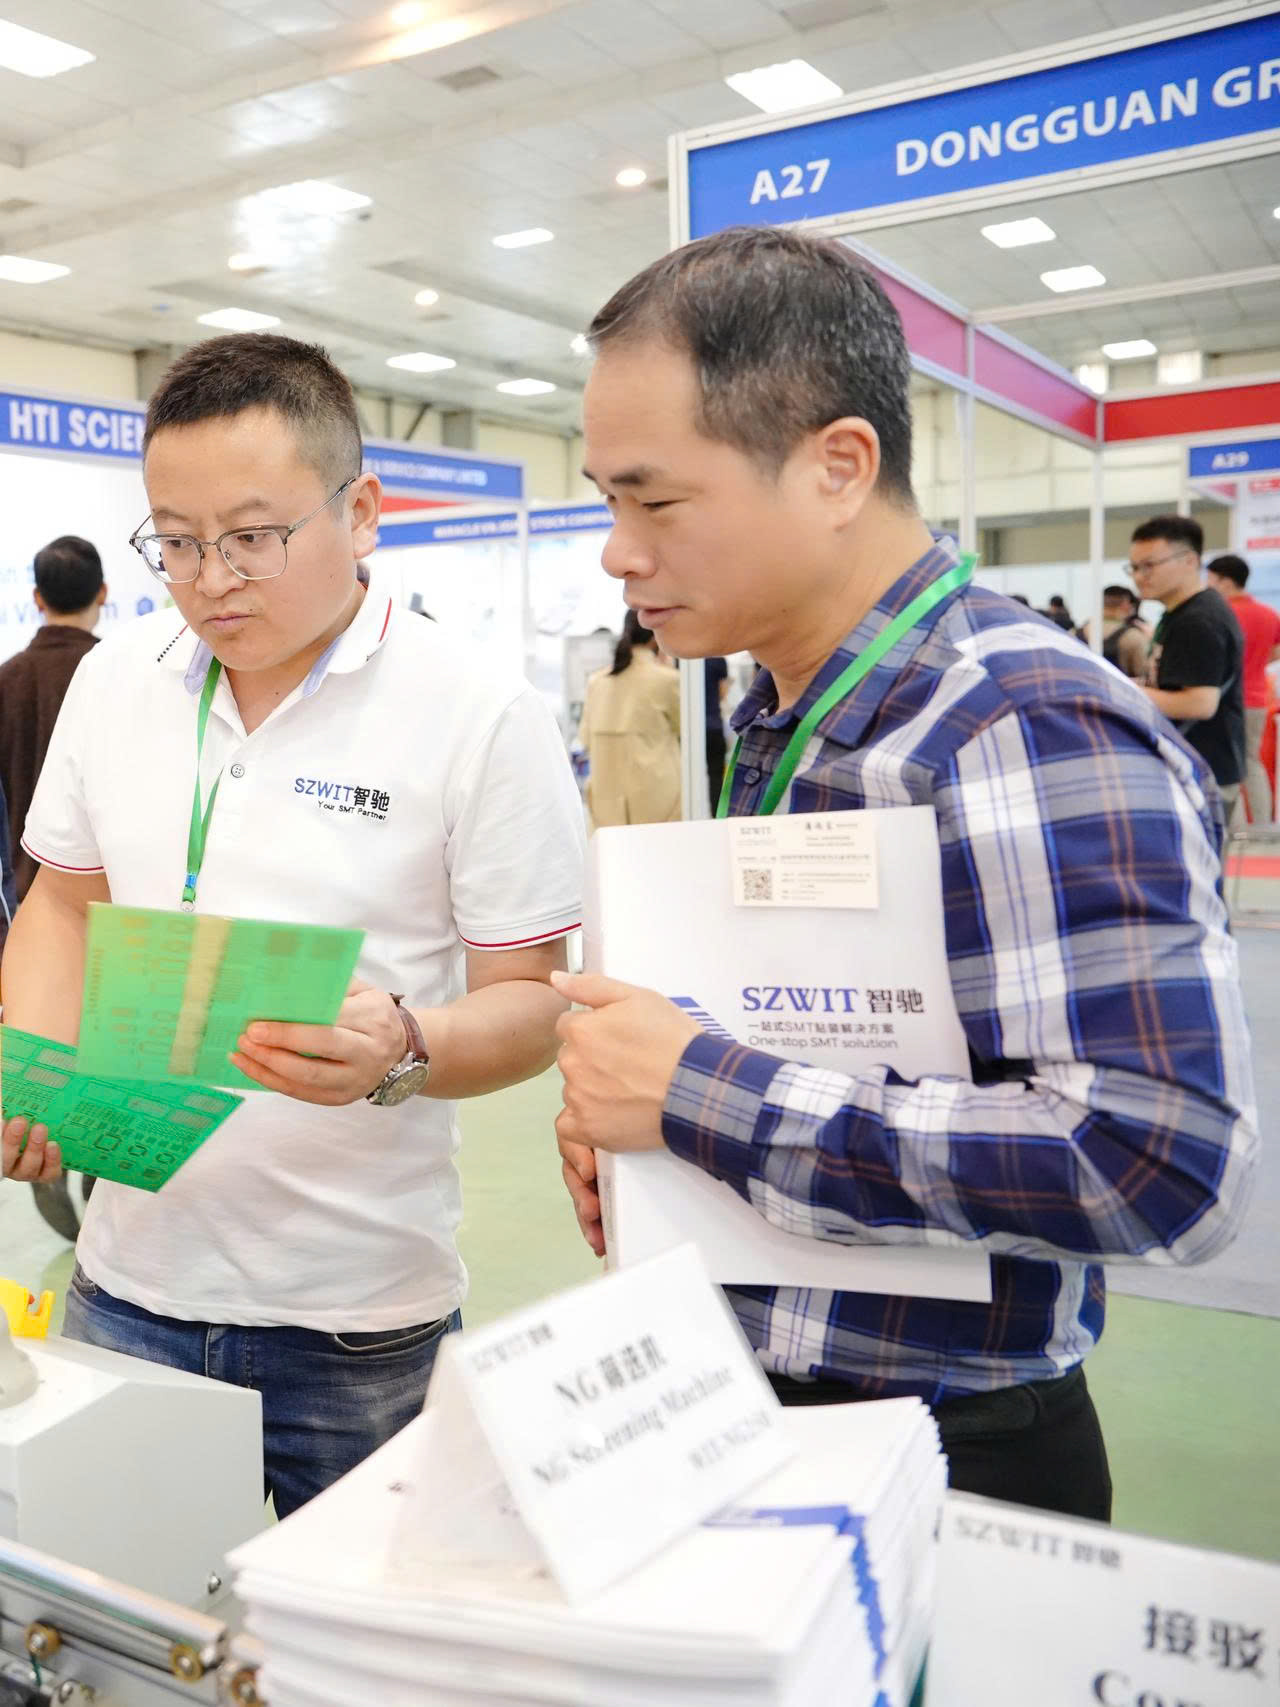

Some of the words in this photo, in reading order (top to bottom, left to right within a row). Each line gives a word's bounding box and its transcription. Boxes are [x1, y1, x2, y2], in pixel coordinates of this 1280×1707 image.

[750, 158, 831, 205] A27
[895, 78, 1198, 177] DONGGUAN
[9, 399, 60, 444] HTI
[317, 800, 336, 811] Your
[338, 804, 355, 814] SMT
[357, 807, 387, 821] Partner
[742, 986, 859, 1014] SZWIT
[866, 988, 925, 1014] 智驰
[748, 1035, 808, 1049] One-stop
[810, 1037, 839, 1048] SMT
[842, 1037, 899, 1049] solution
[552, 1367, 601, 1407] NG
[659, 1366, 734, 1412] Machine
[955, 1515, 1059, 1558] SZWIT
[1143, 1604, 1280, 1679] 接驳
